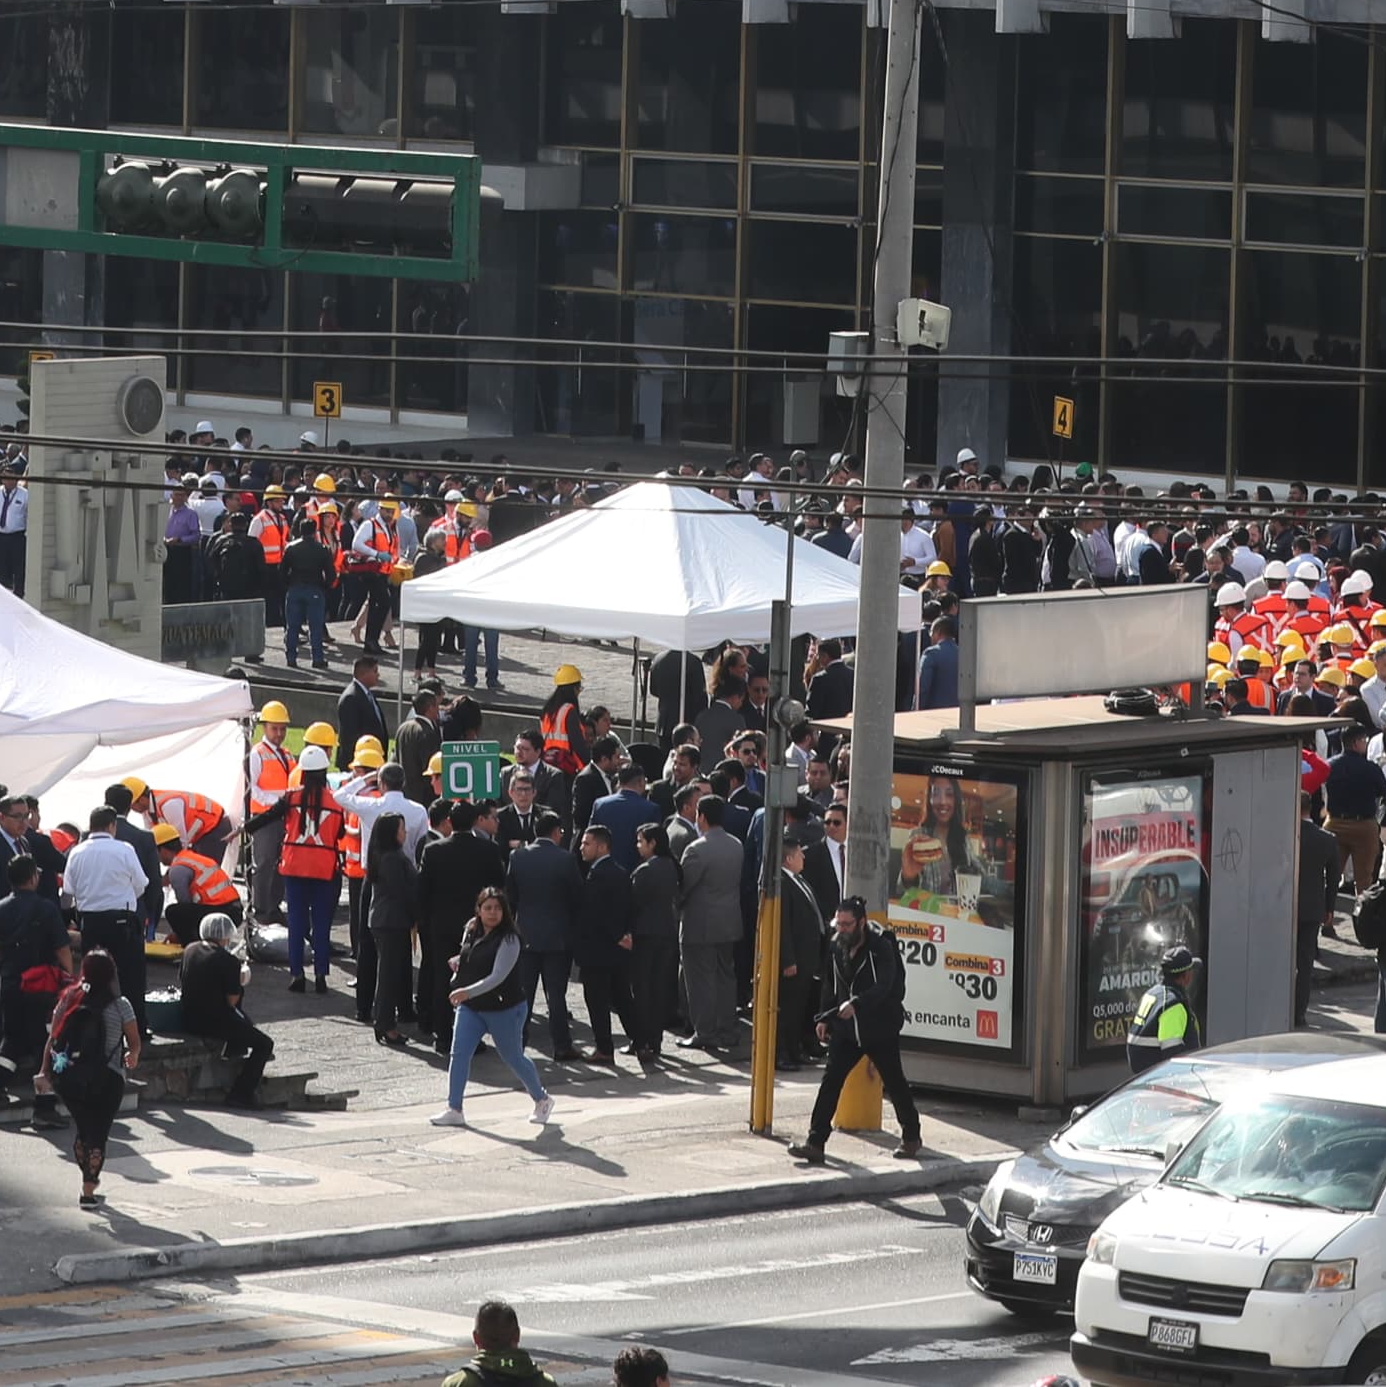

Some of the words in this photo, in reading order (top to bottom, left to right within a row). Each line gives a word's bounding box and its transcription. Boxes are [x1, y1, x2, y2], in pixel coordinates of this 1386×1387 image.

[320, 389, 335, 413] 3
[1057, 404, 1068, 431] 4
[453, 744, 487, 753] NIVEL
[449, 761, 493, 794] 01
[1095, 819, 1196, 859] INSUPERABLE
[932, 926, 942, 941] 2
[945, 955, 989, 970] Combina
[992, 959, 1003, 975] 3
[915, 1009, 971, 1029] encanta
[1093, 1003, 1125, 1018] Q5,000
